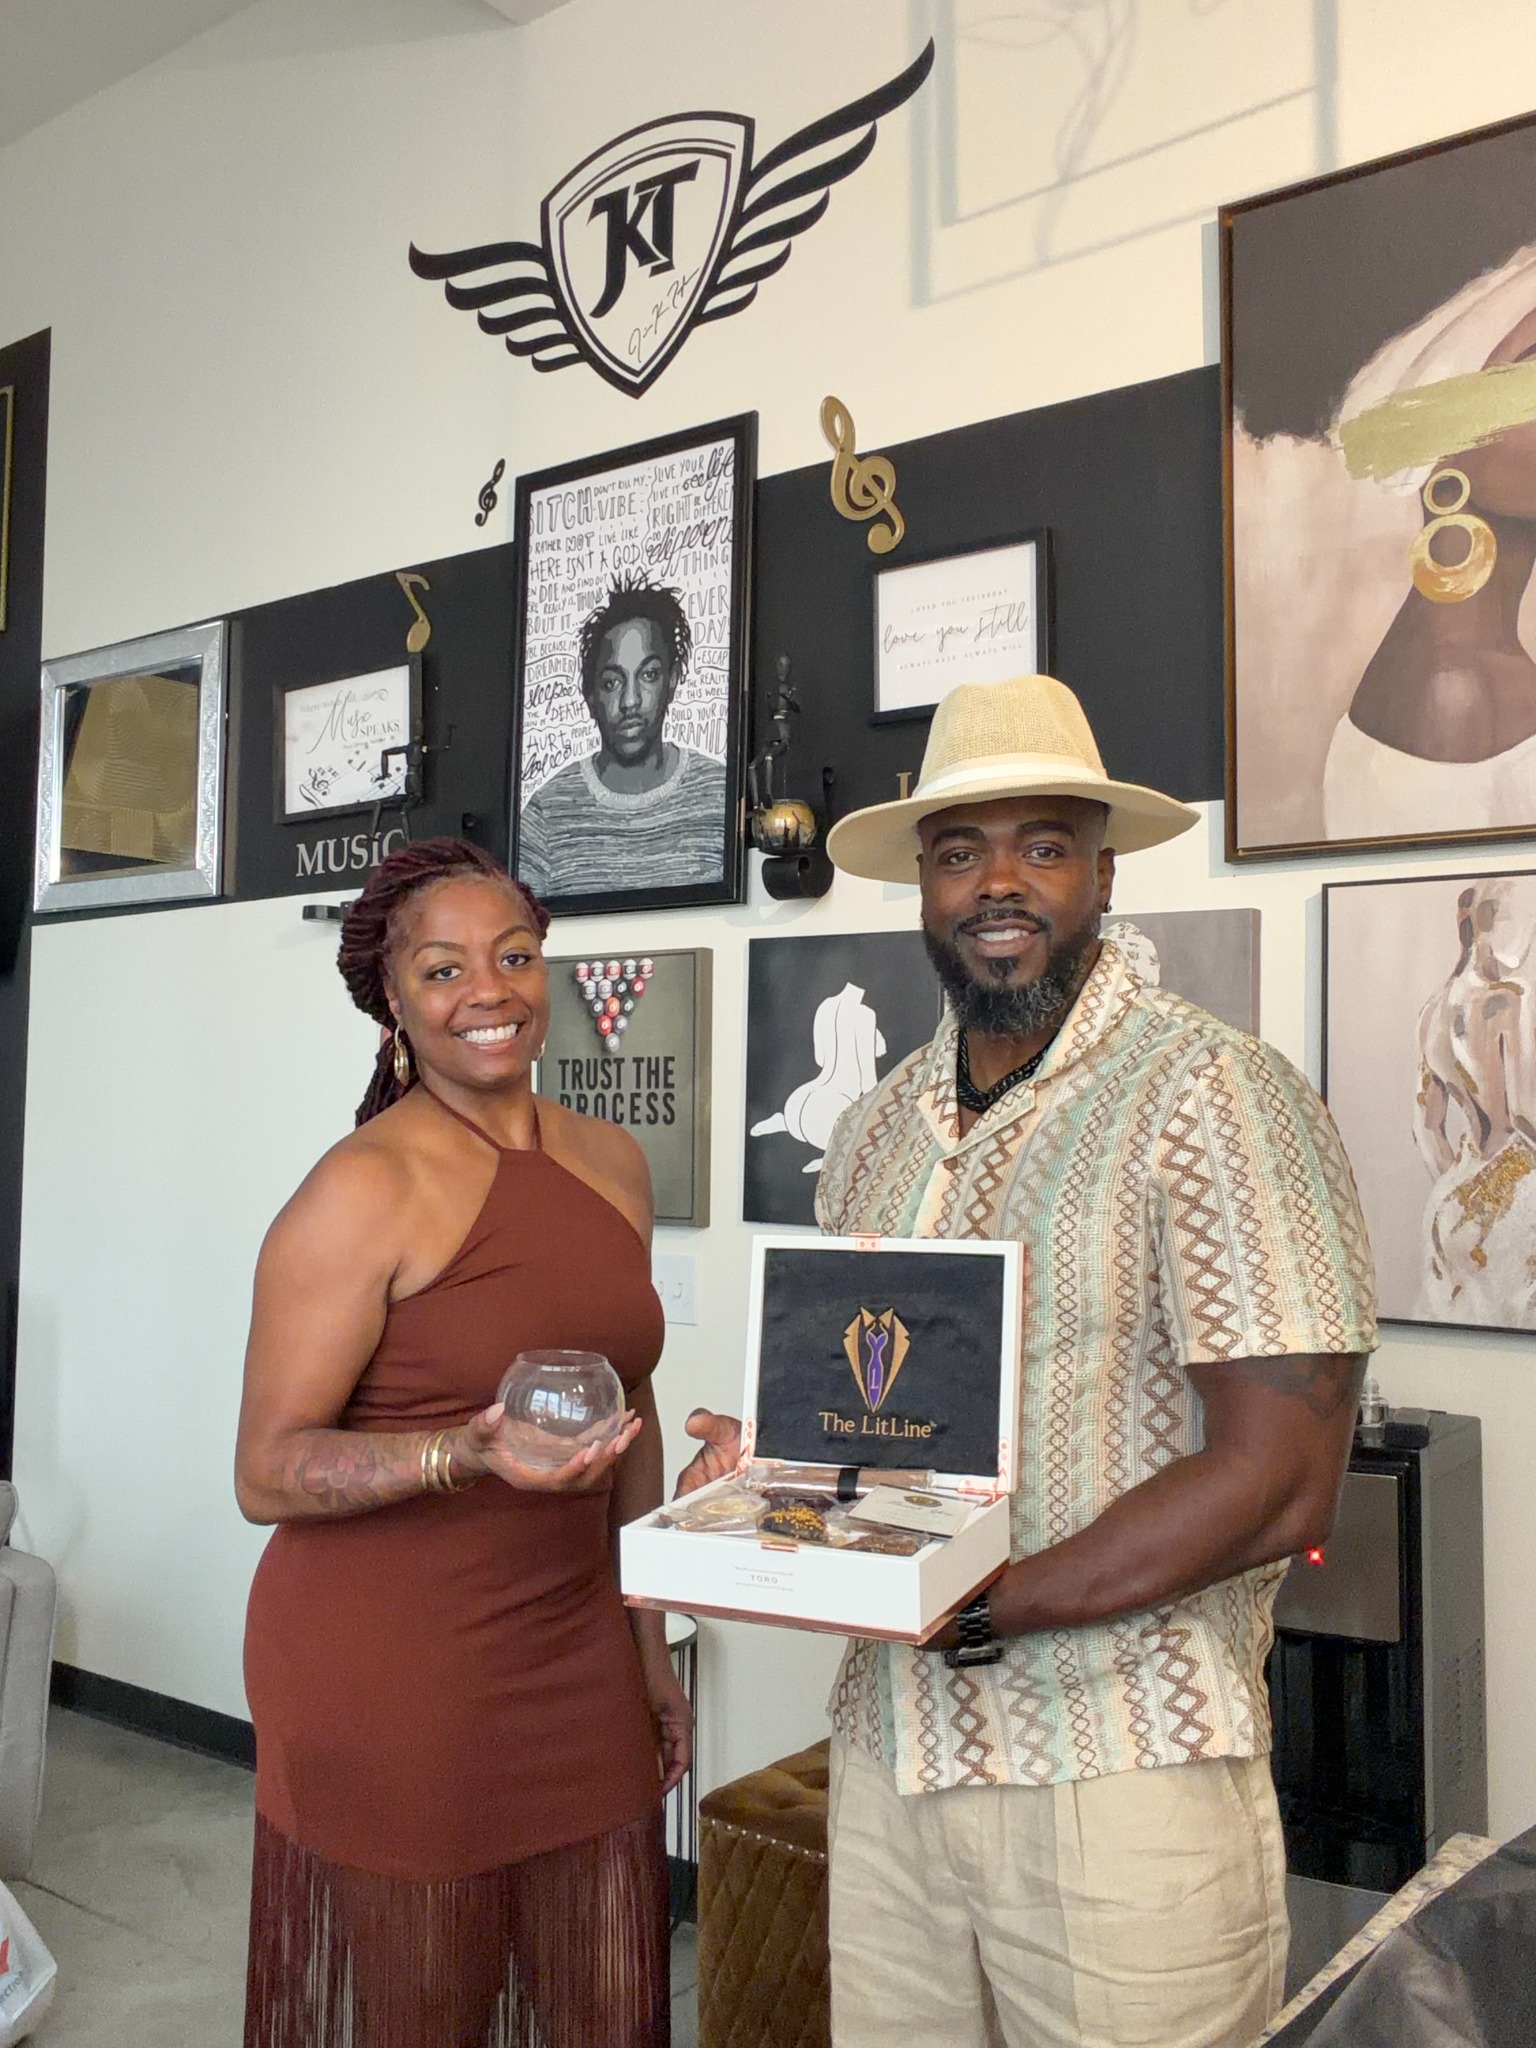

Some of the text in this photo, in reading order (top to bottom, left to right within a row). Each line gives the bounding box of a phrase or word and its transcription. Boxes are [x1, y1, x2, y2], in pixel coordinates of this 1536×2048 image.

[658, 464, 676, 482] LIVE
[680, 454, 704, 477] YOUR
[598, 492, 637, 521] VIBE
[653, 485, 680, 502] LIVE IT
[652, 493, 693, 529] RIGHT
[565, 531, 595, 553] NOT
[599, 531, 617, 546] LIVE
[621, 525, 639, 541] LIKE
[529, 556, 562, 582] HERE
[613, 543, 640, 570] GOD
[695, 616, 727, 646] DAY
[883, 600, 1029, 654] love you still
[527, 657, 575, 683] DREAMER
[687, 688, 702, 699] THIS
[550, 698, 586, 721] DEATH
[671, 707, 692, 723] BUILD
[697, 702, 717, 721] YOUR
[360, 719, 400, 737] SPEAKS
[526, 730, 567, 754] HURT
[558, 1056, 676, 1091] TRUST THE
[818, 1411, 856, 1433] The
